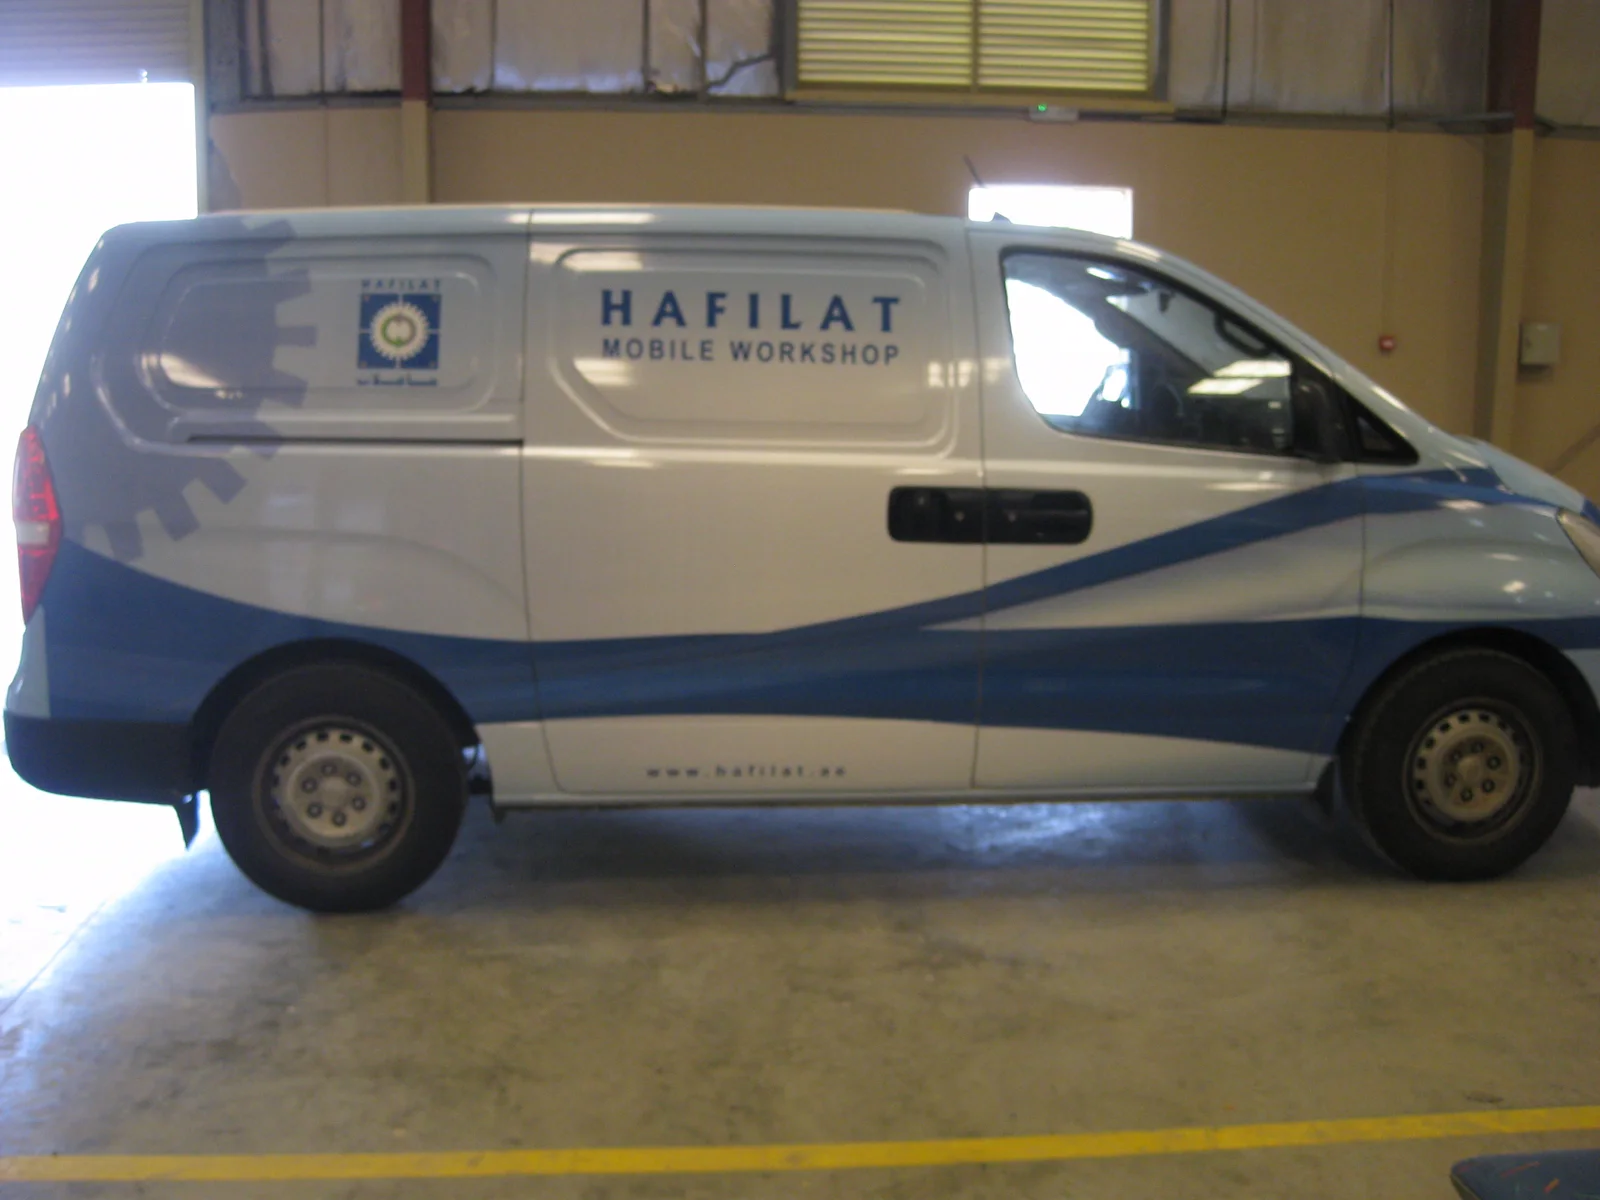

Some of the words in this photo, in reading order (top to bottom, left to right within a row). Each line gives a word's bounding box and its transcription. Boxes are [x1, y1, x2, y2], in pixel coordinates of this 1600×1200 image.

[600, 288, 900, 333] HAFILAT
[601, 338, 714, 361] MOBILE
[729, 341, 900, 365] WORKSHOP
